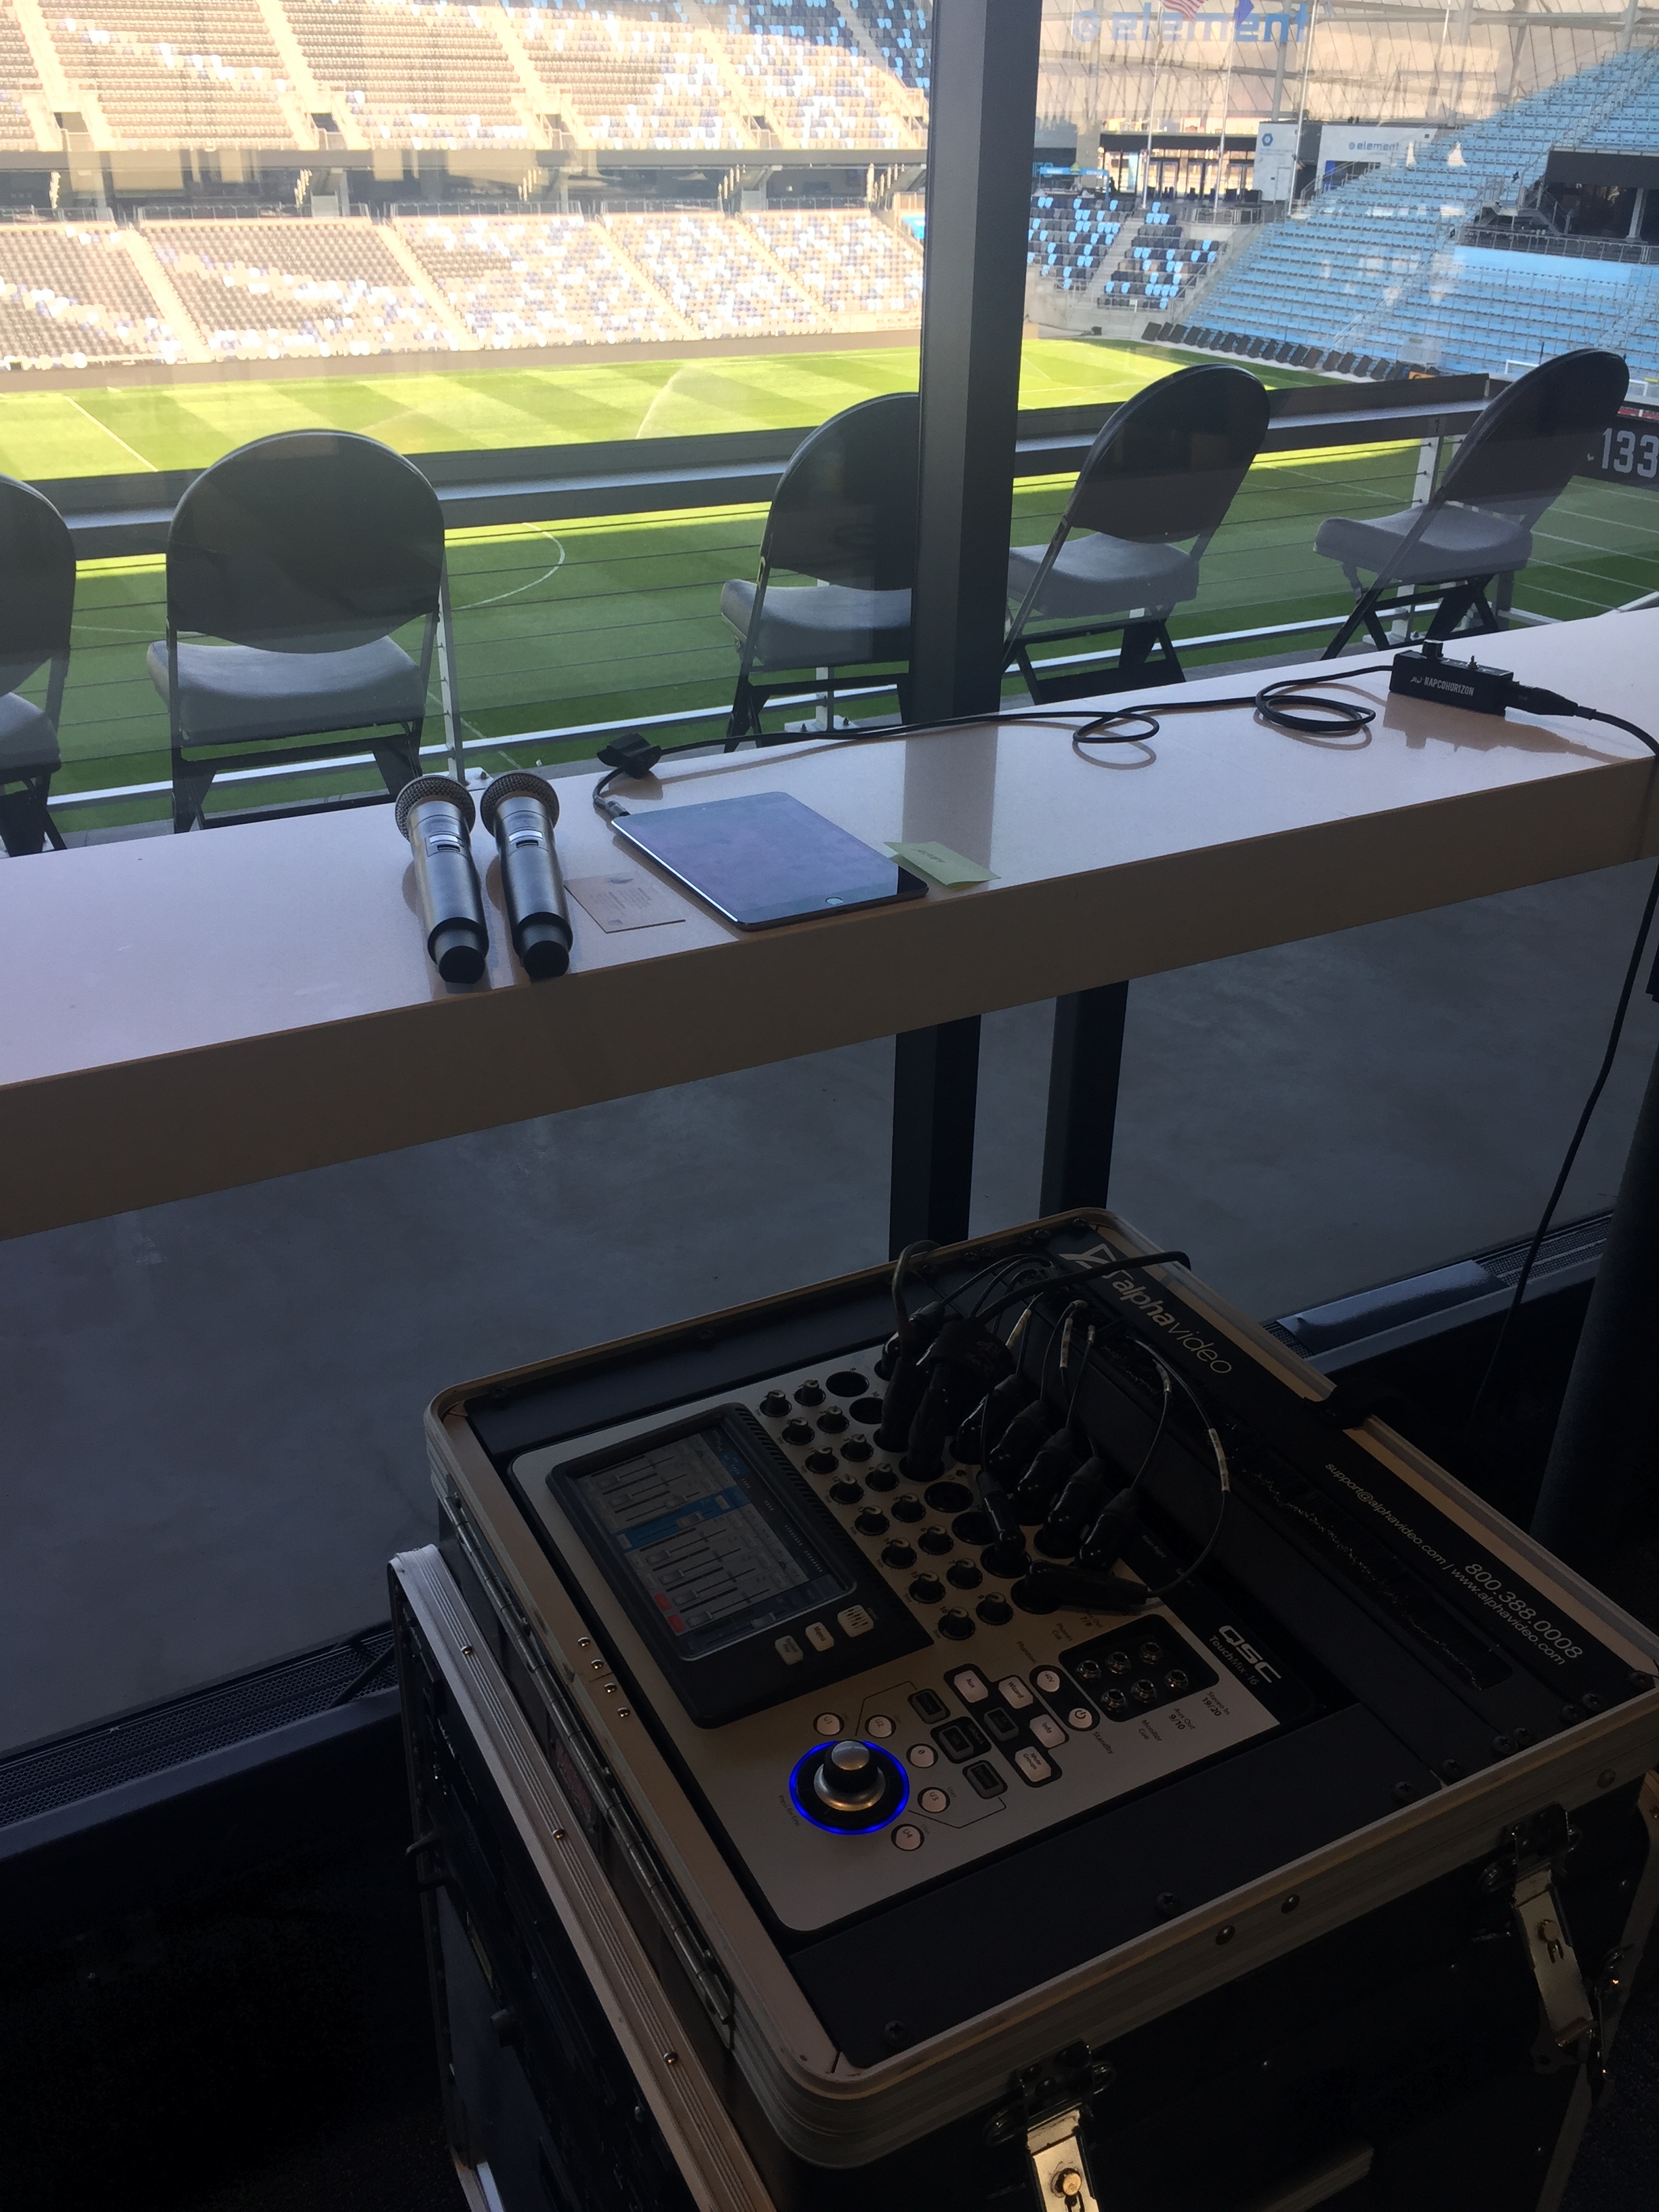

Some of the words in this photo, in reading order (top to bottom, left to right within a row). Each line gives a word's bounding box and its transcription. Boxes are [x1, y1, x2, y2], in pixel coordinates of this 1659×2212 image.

[1112, 2, 1309, 42] element
[1357, 140, 1399, 151] element
[1601, 427, 1659, 478] 133
[1424, 676, 1475, 697] RAPCOHORIZON
[1112, 1279, 1233, 1374] alphavideo
[1325, 1462, 1446, 1565] support@alphavideo.com
[1451, 1569, 1565, 1666] www.alphavideo.com
[939, 1605, 947, 1614] 16
[1465, 1563, 1583, 1659] 800.388.0008
[813, 1626, 826, 1641] Menu
[1052, 1630, 1062, 1640] Cue
[1056, 1622, 1073, 1641] Phones
[1017, 1641, 1038, 1664] Phantom
[1218, 1624, 1282, 1683] QSC
[1008, 1681, 1025, 1699] Wizard
[1202, 1697, 1222, 1717] 19/20
[1207, 1691, 1225, 1709] Stereo
[823, 1716, 832, 1725] U1
[875, 1718, 884, 1727] U2
[1042, 1722, 1052, 1734] Info
[1168, 1714, 1186, 1730] 9/10
[1174, 1708, 1185, 1719] Aux
[1185, 1718, 1195, 1730] Out
[1139, 1728, 1149, 1740] Cue
[1141, 1719, 1162, 1742] Monitor
[1092, 1731, 1114, 1755] Standby
[929, 1791, 939, 1801] U3
[903, 1828, 913, 1839] U4
